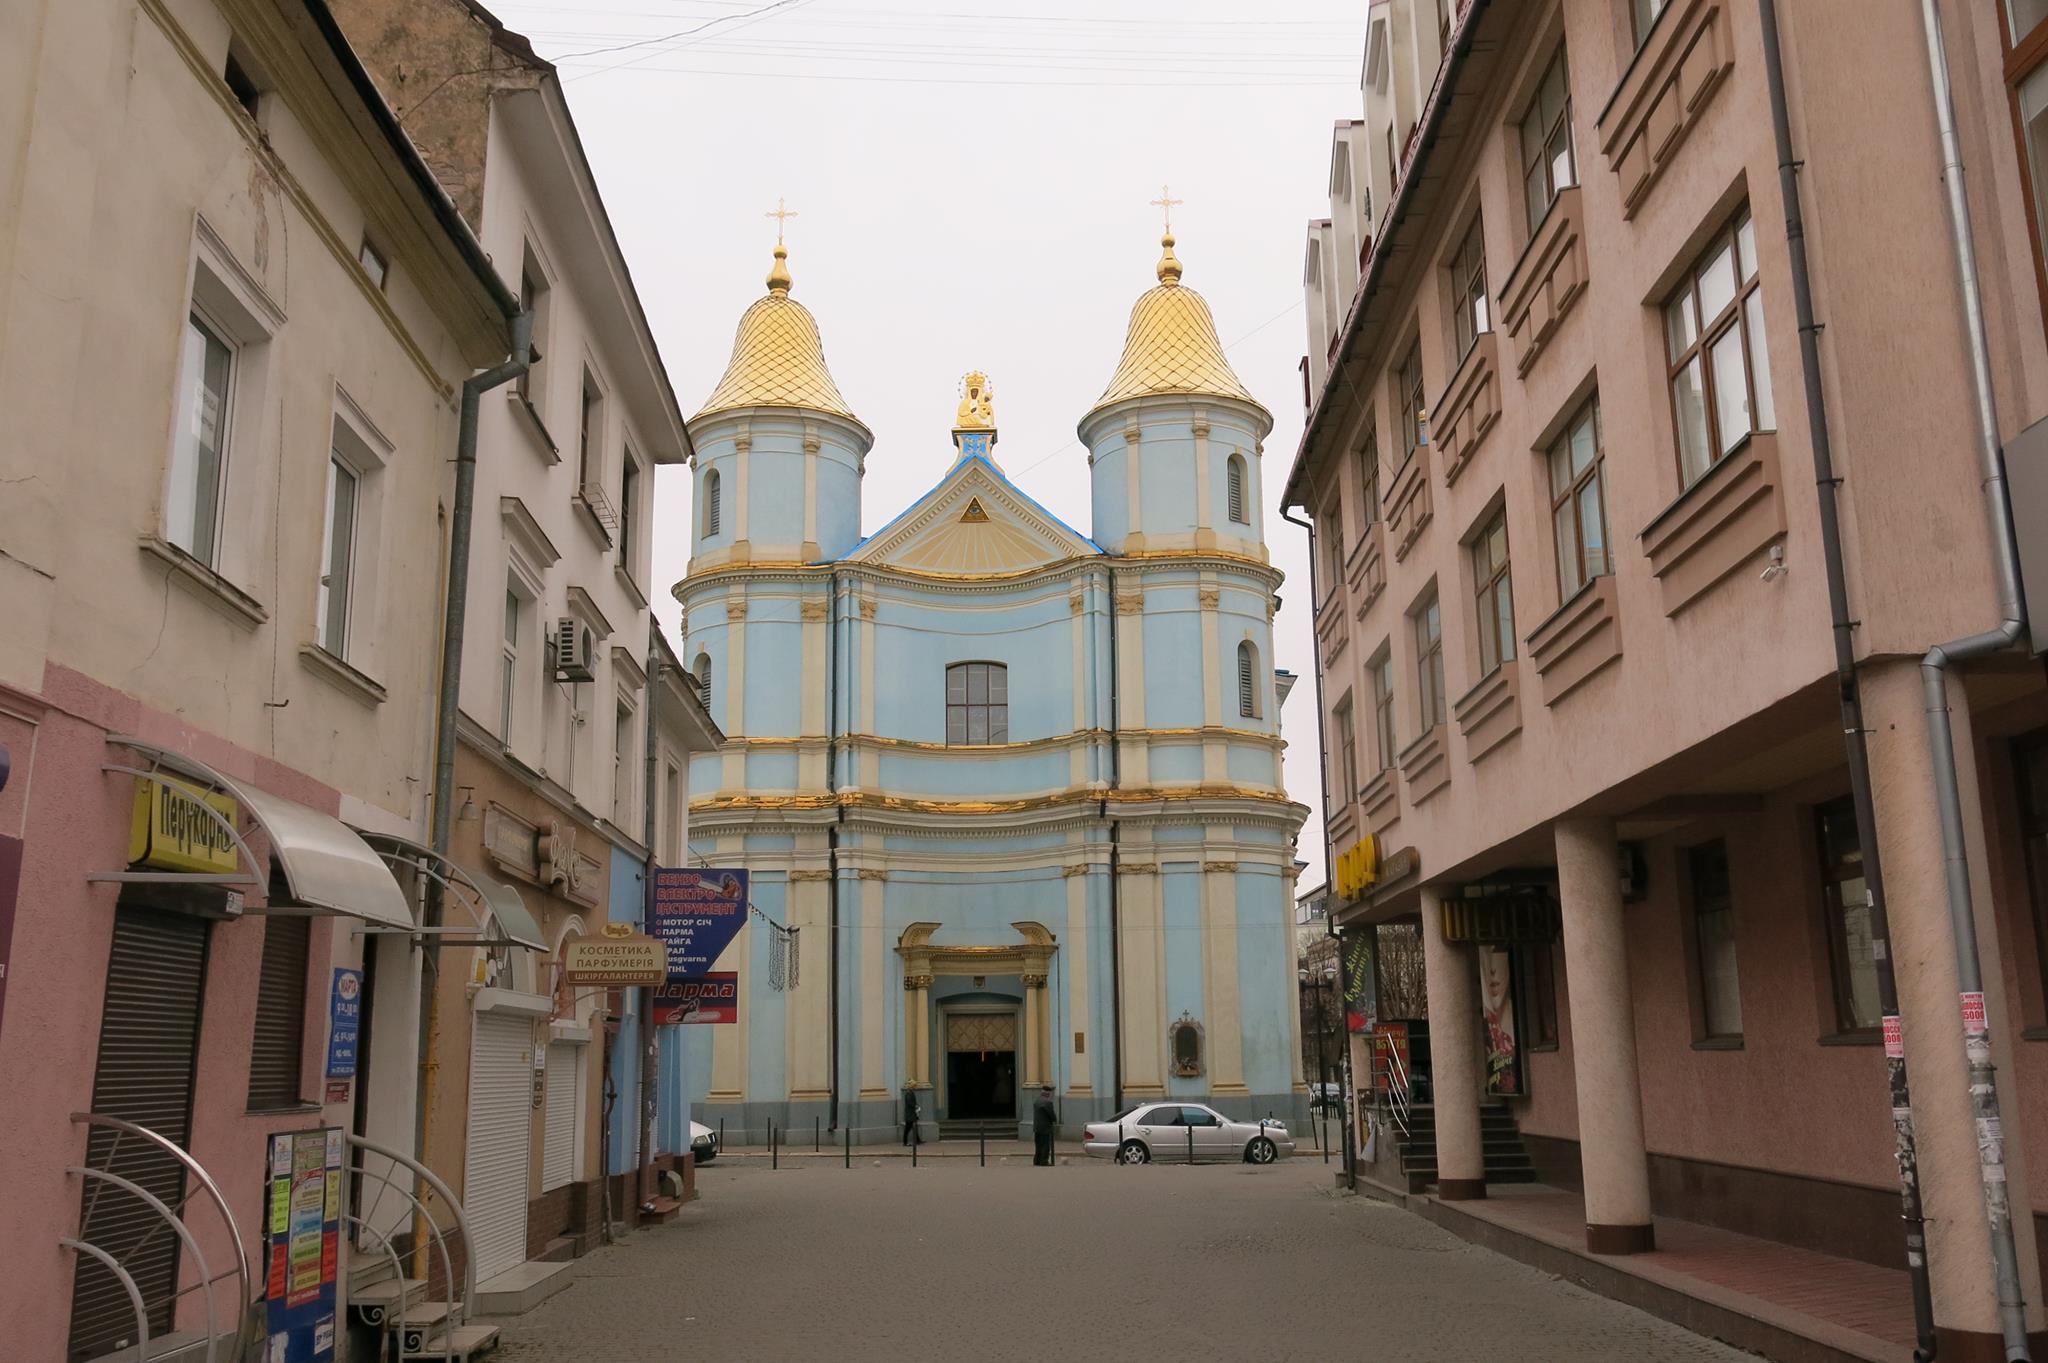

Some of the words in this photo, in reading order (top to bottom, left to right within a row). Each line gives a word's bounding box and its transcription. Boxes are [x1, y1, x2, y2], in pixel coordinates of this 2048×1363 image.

[656, 888, 716, 900] ЕЛЕКТРО
[655, 902, 738, 915] ІНСТРУМЕНТ
[579, 946, 653, 955] КОСМЕТИКА
[576, 957, 654, 969] ПАРФУМЕРІЯ
[667, 956, 707, 964] usgvarna
[667, 965, 687, 973] TIHL
[575, 972, 655, 980] ШКІРГАЛАНТЕРЕЯ
